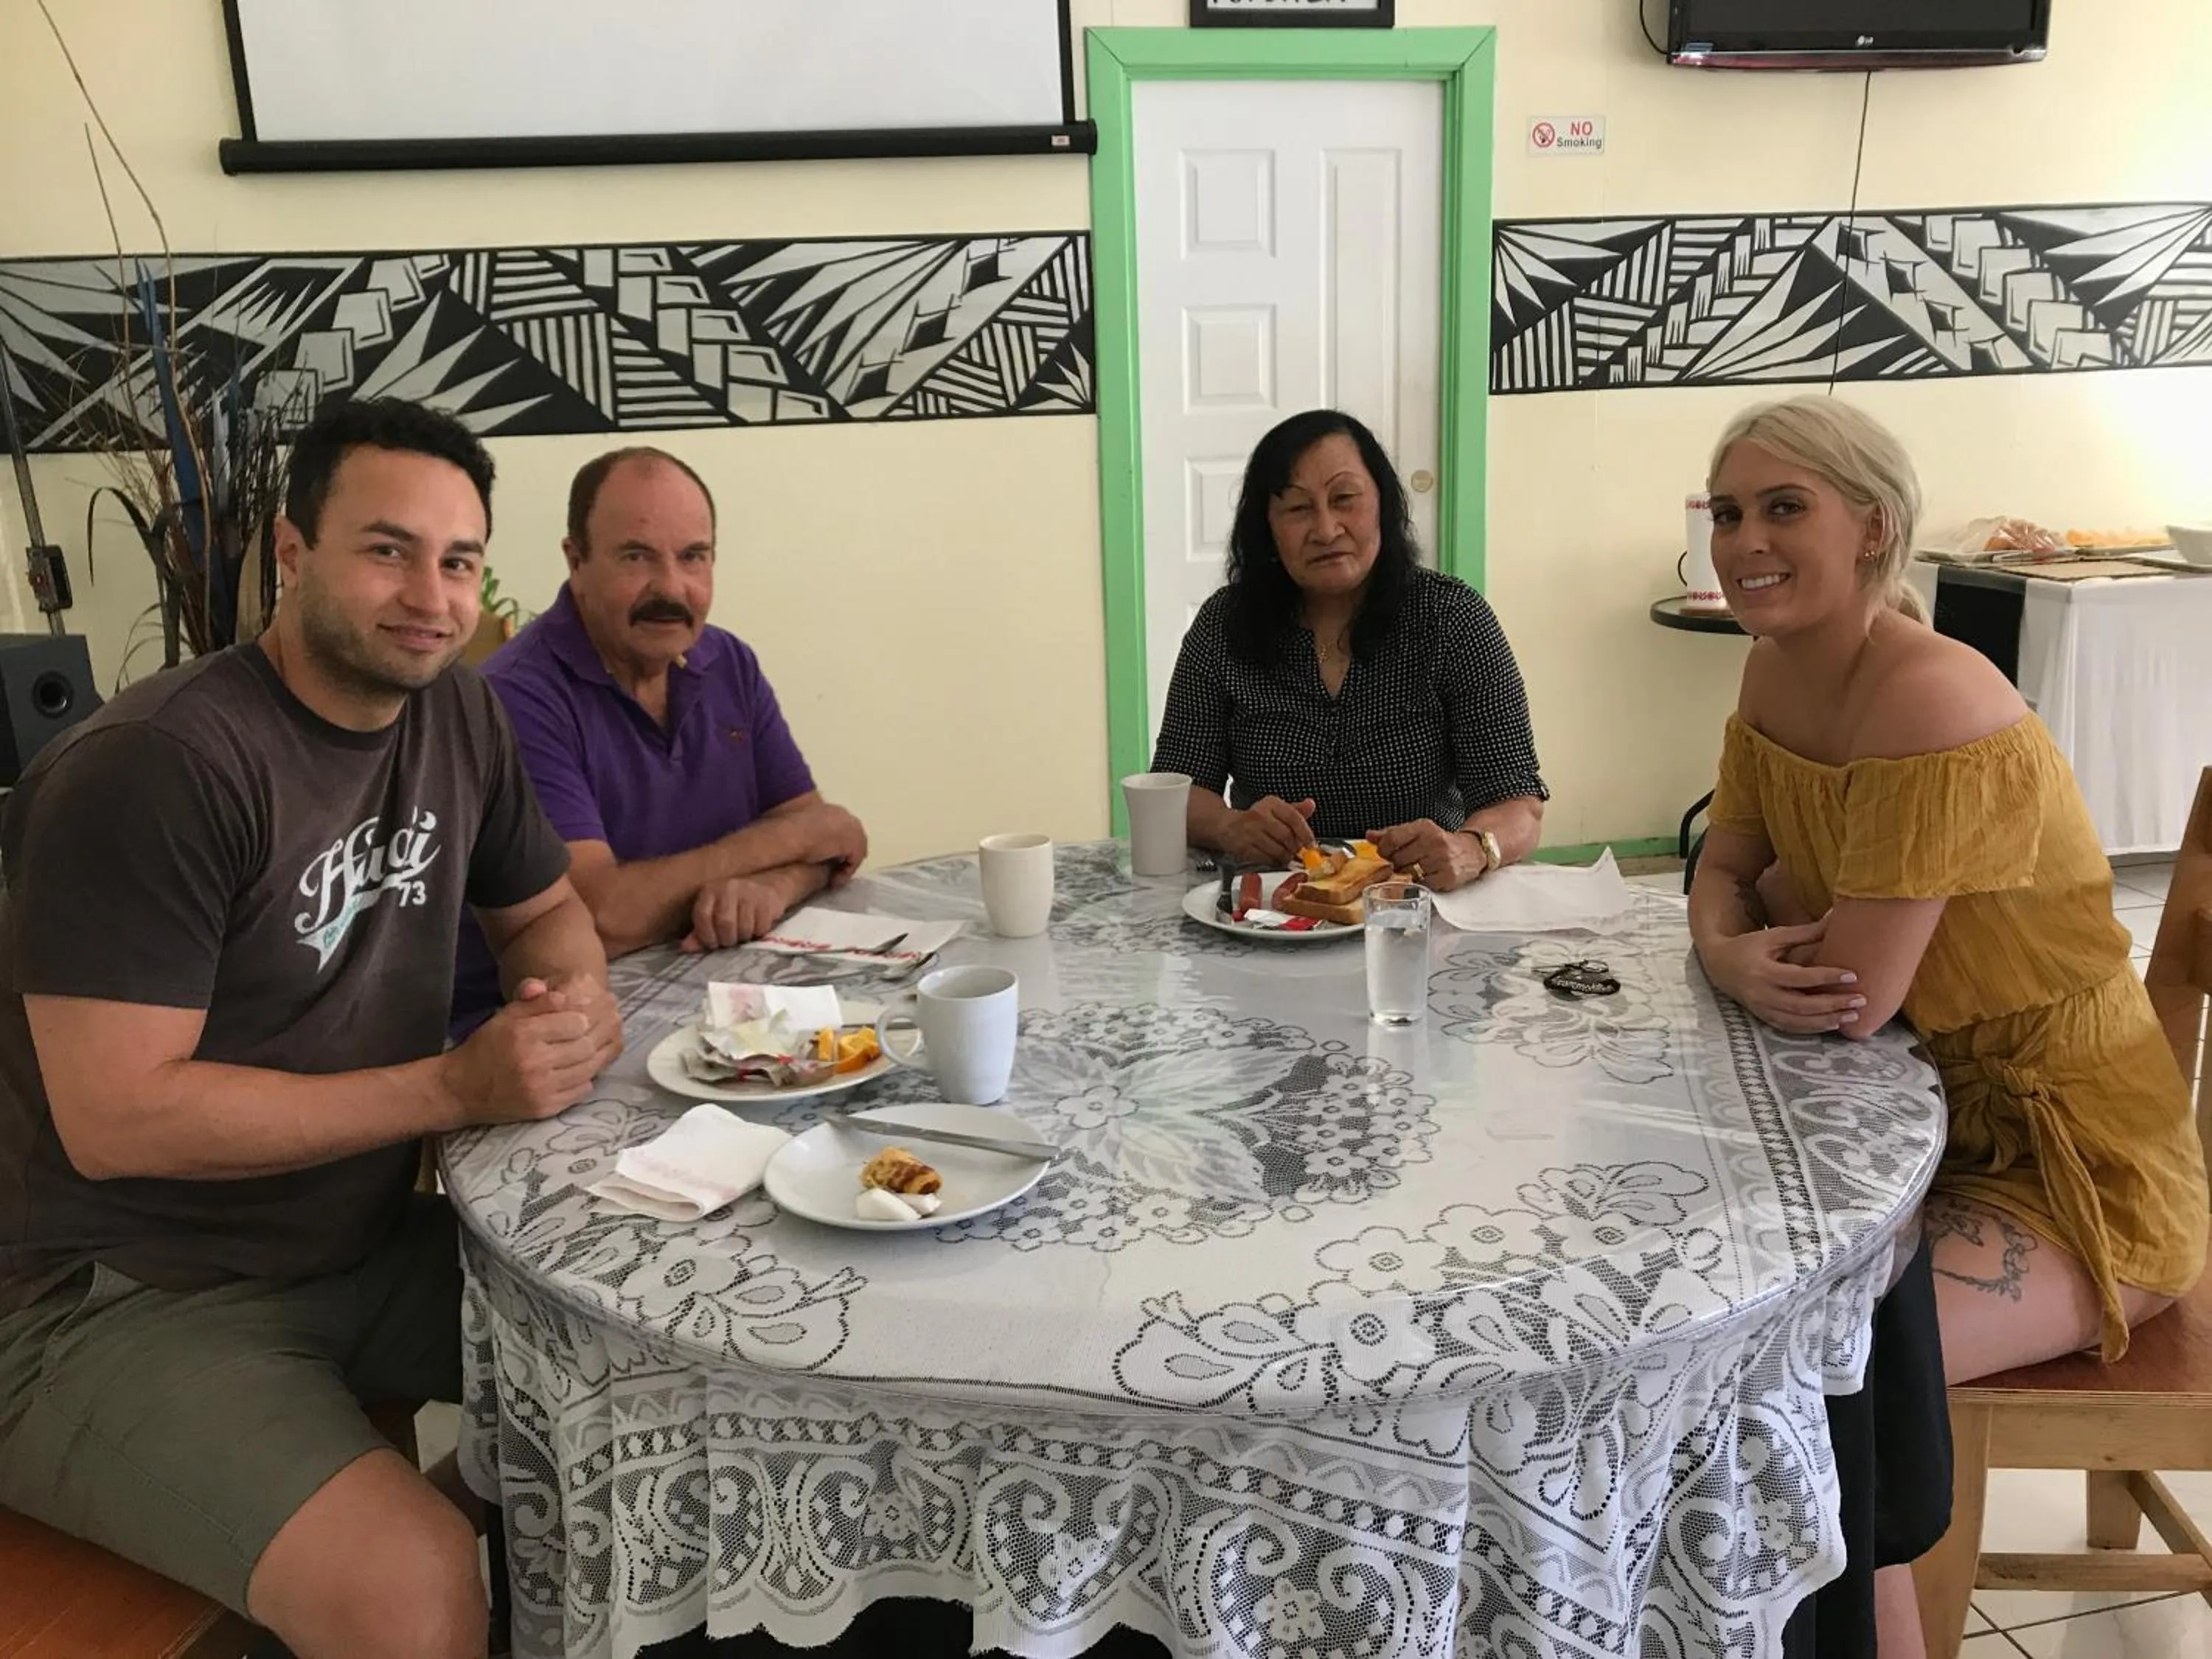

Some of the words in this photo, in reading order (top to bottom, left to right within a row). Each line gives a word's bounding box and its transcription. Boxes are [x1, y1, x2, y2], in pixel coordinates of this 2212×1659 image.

[1570, 121, 1593, 136] NO
[1556, 137, 1602, 149] Smoking
[399, 880, 427, 908] 73
